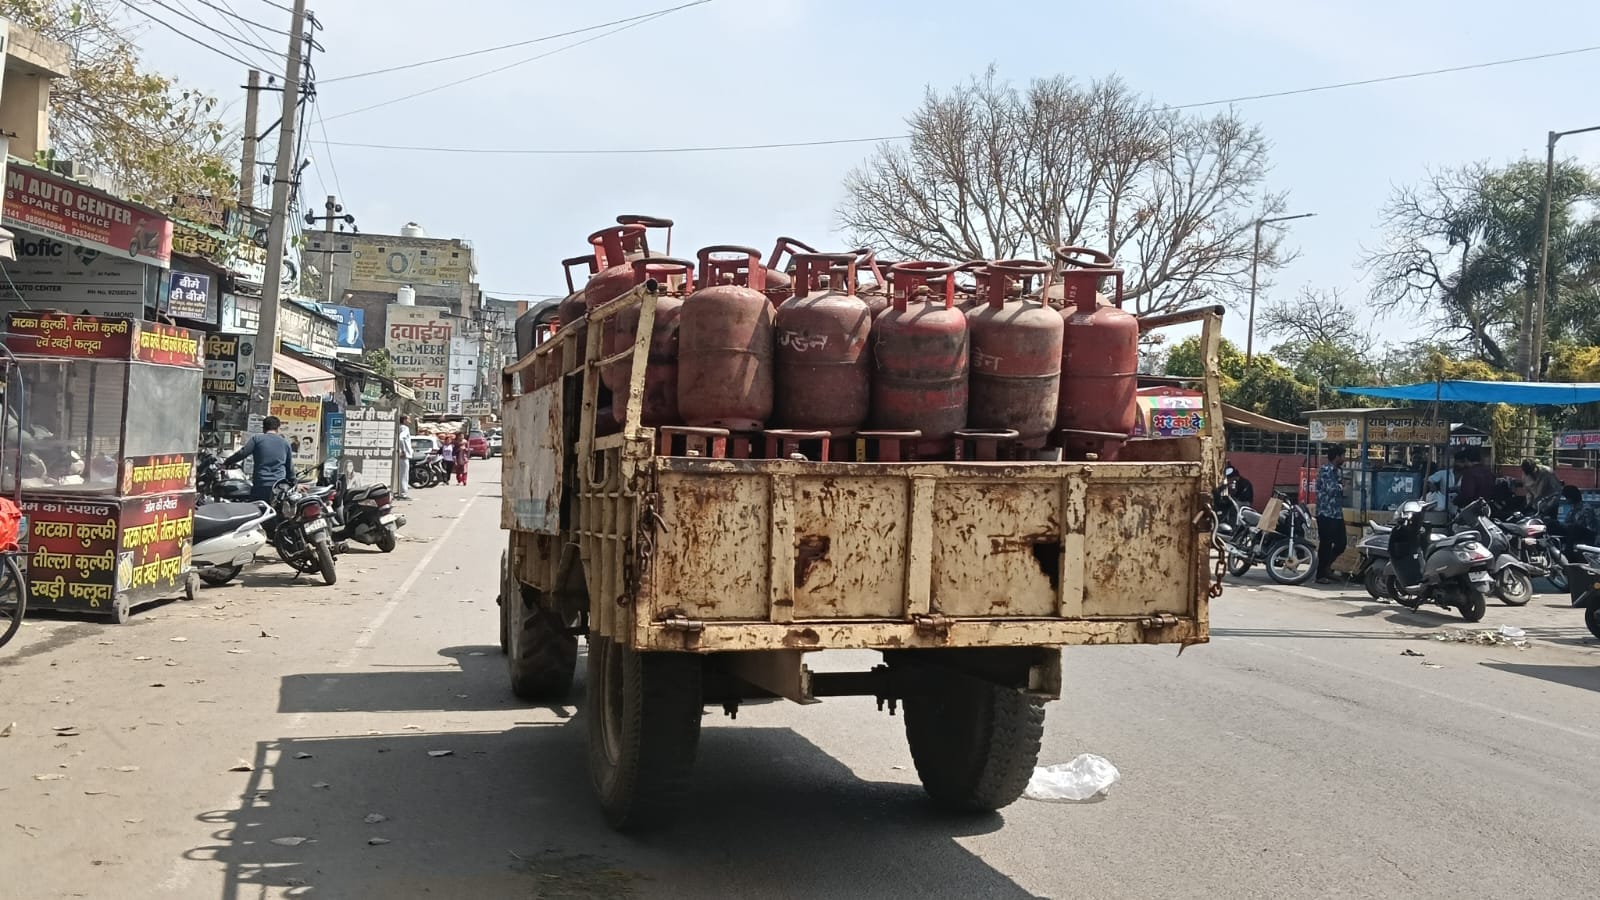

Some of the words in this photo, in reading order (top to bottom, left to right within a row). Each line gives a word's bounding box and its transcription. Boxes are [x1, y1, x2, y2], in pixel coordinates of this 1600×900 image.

[21, 195, 59, 213] SPARE
[64, 209, 110, 228] SERVICE
[28, 178, 73, 207] AUTO
[77, 195, 132, 225] CENTER
[15, 238, 62, 256] lofic
[12, 318, 38, 329] मटका
[100, 320, 128, 337] कुल्फी
[390, 320, 452, 344] दवाईयां
[74, 340, 101, 354] फलूदा
[35, 521, 72, 540] मटका
[76, 519, 116, 547] कुल्फी
[123, 525, 141, 548] मटका
[32, 546, 72, 570] तील्ला
[75, 550, 115, 578] कुल्फी
[31, 576, 66, 602] रबड़ी
[69, 582, 113, 607] फलूदा
